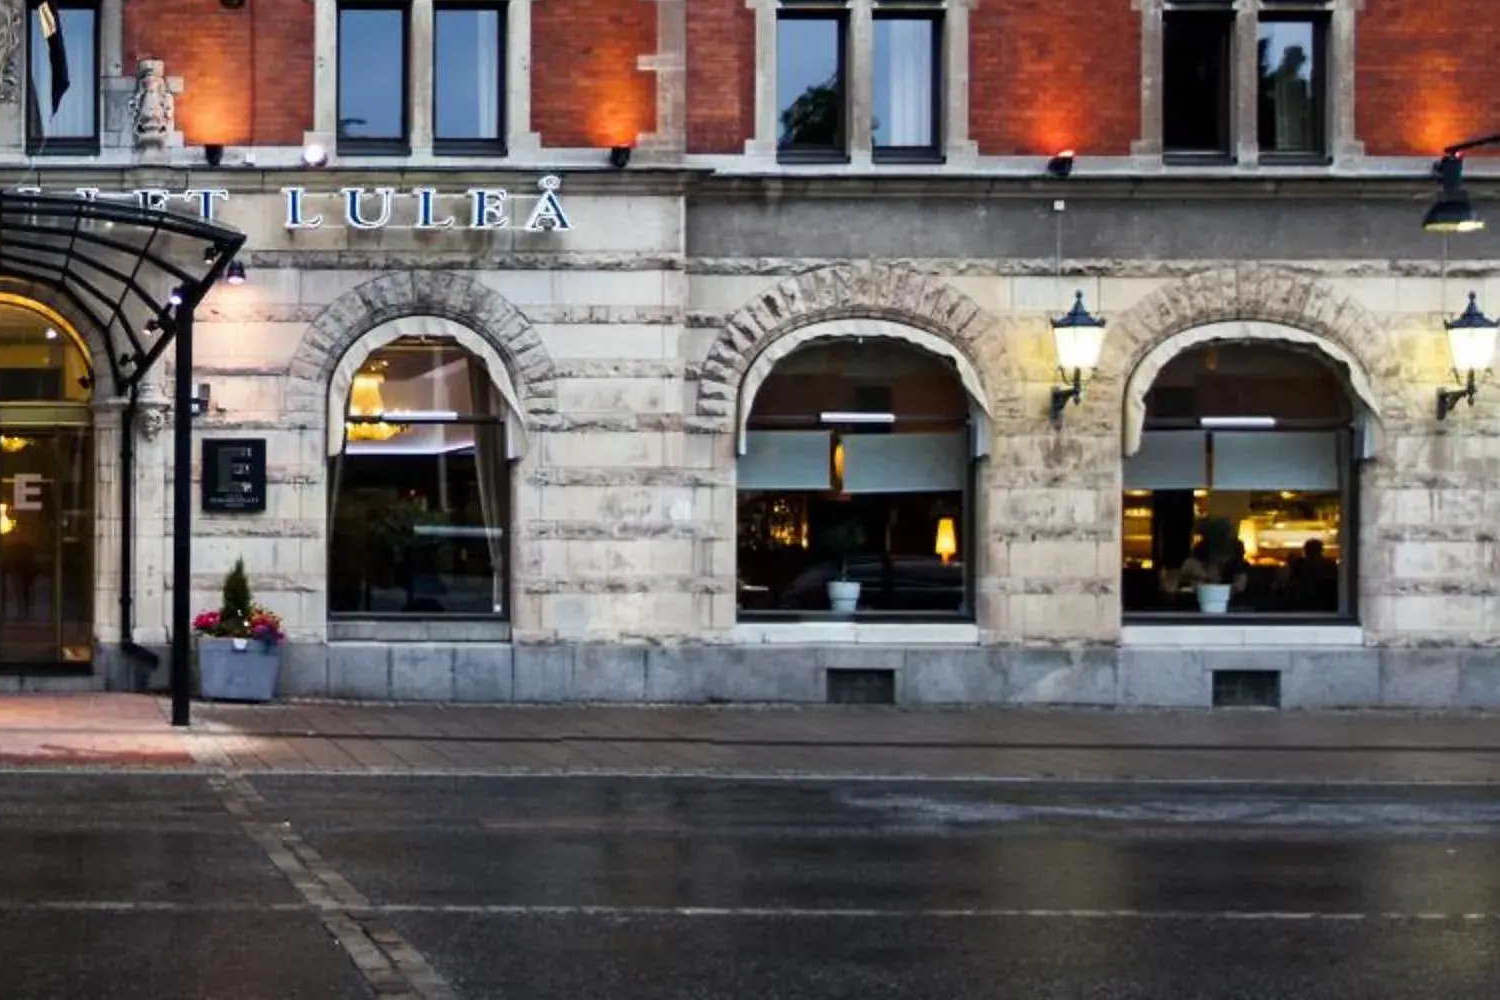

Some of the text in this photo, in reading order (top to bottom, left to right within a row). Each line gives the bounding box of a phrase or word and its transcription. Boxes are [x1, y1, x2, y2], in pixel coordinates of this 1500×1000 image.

[283, 175, 572, 230] LULEÅ
[14, 473, 42, 510] E
[216, 447, 252, 492] E
